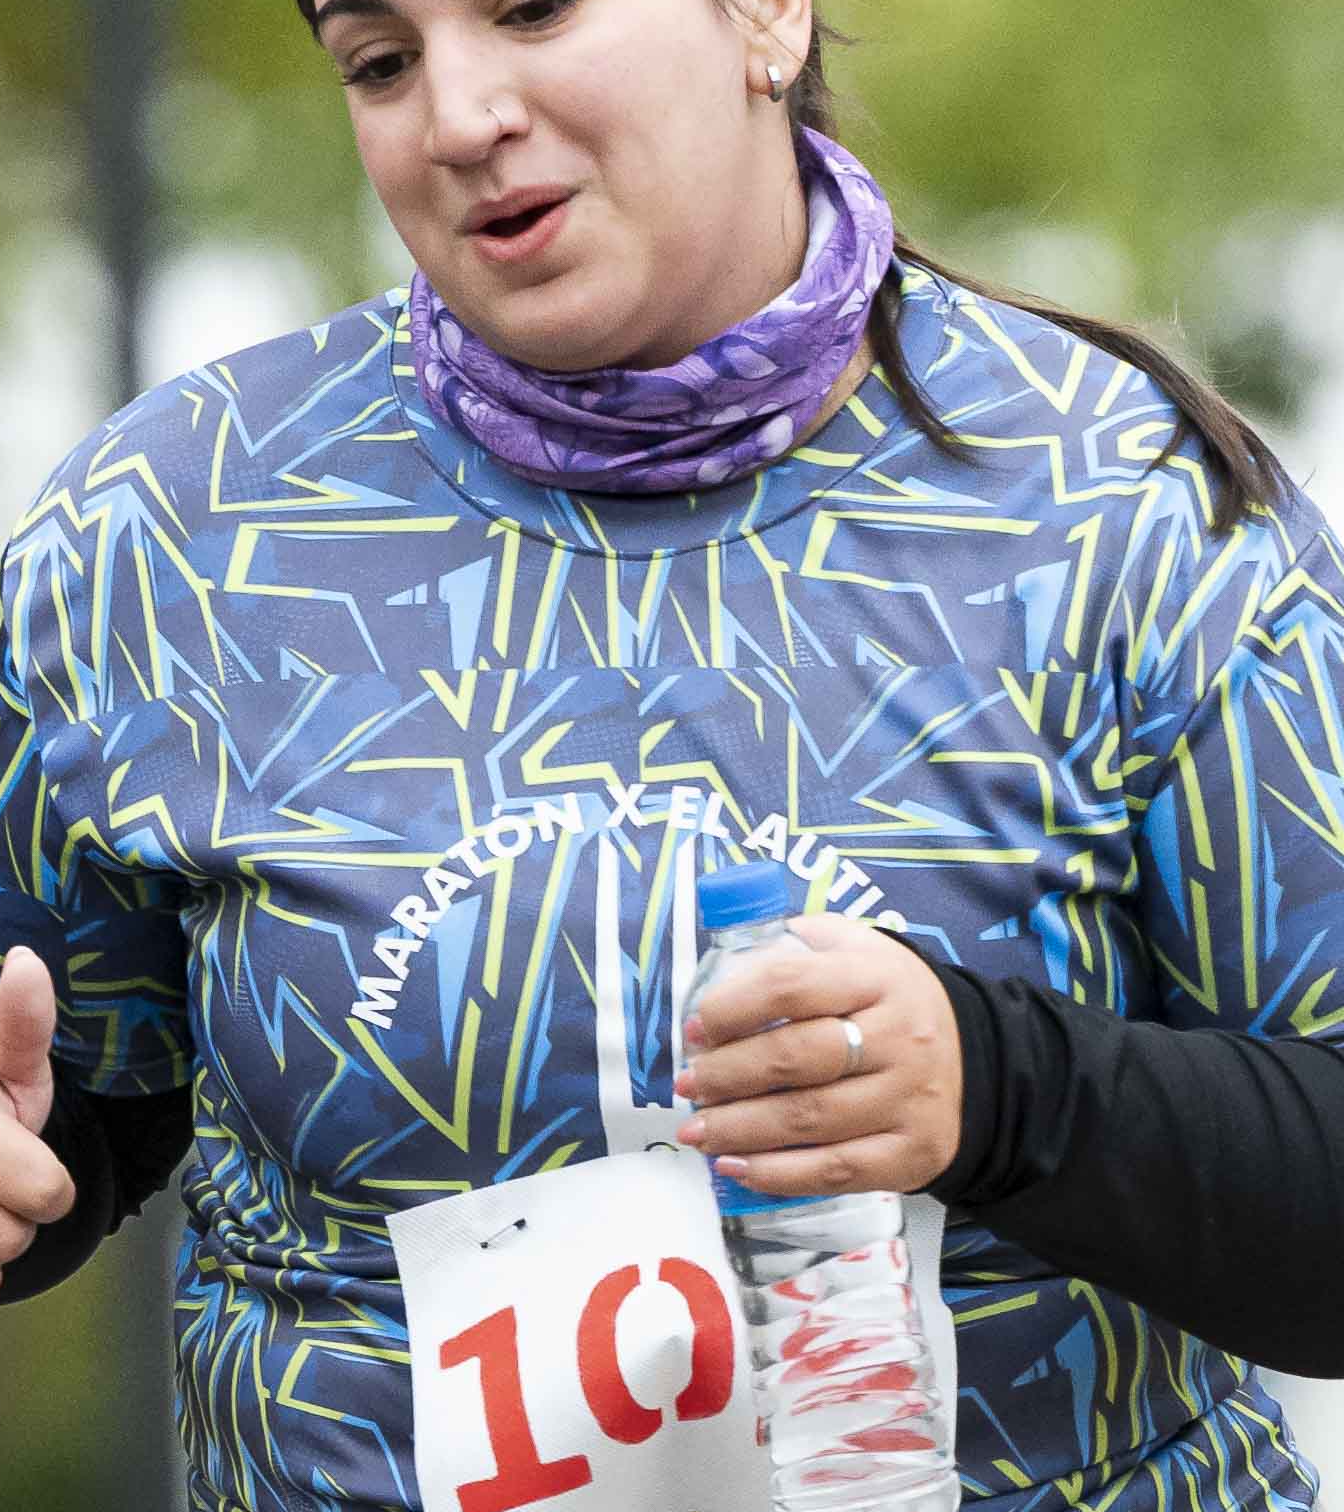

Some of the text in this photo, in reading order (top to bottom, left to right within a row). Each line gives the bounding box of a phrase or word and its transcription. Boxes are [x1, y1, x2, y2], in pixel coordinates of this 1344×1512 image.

[351, 792, 584, 1029] MARATÓN
[606, 784, 648, 827] X
[667, 786, 730, 839] EL
